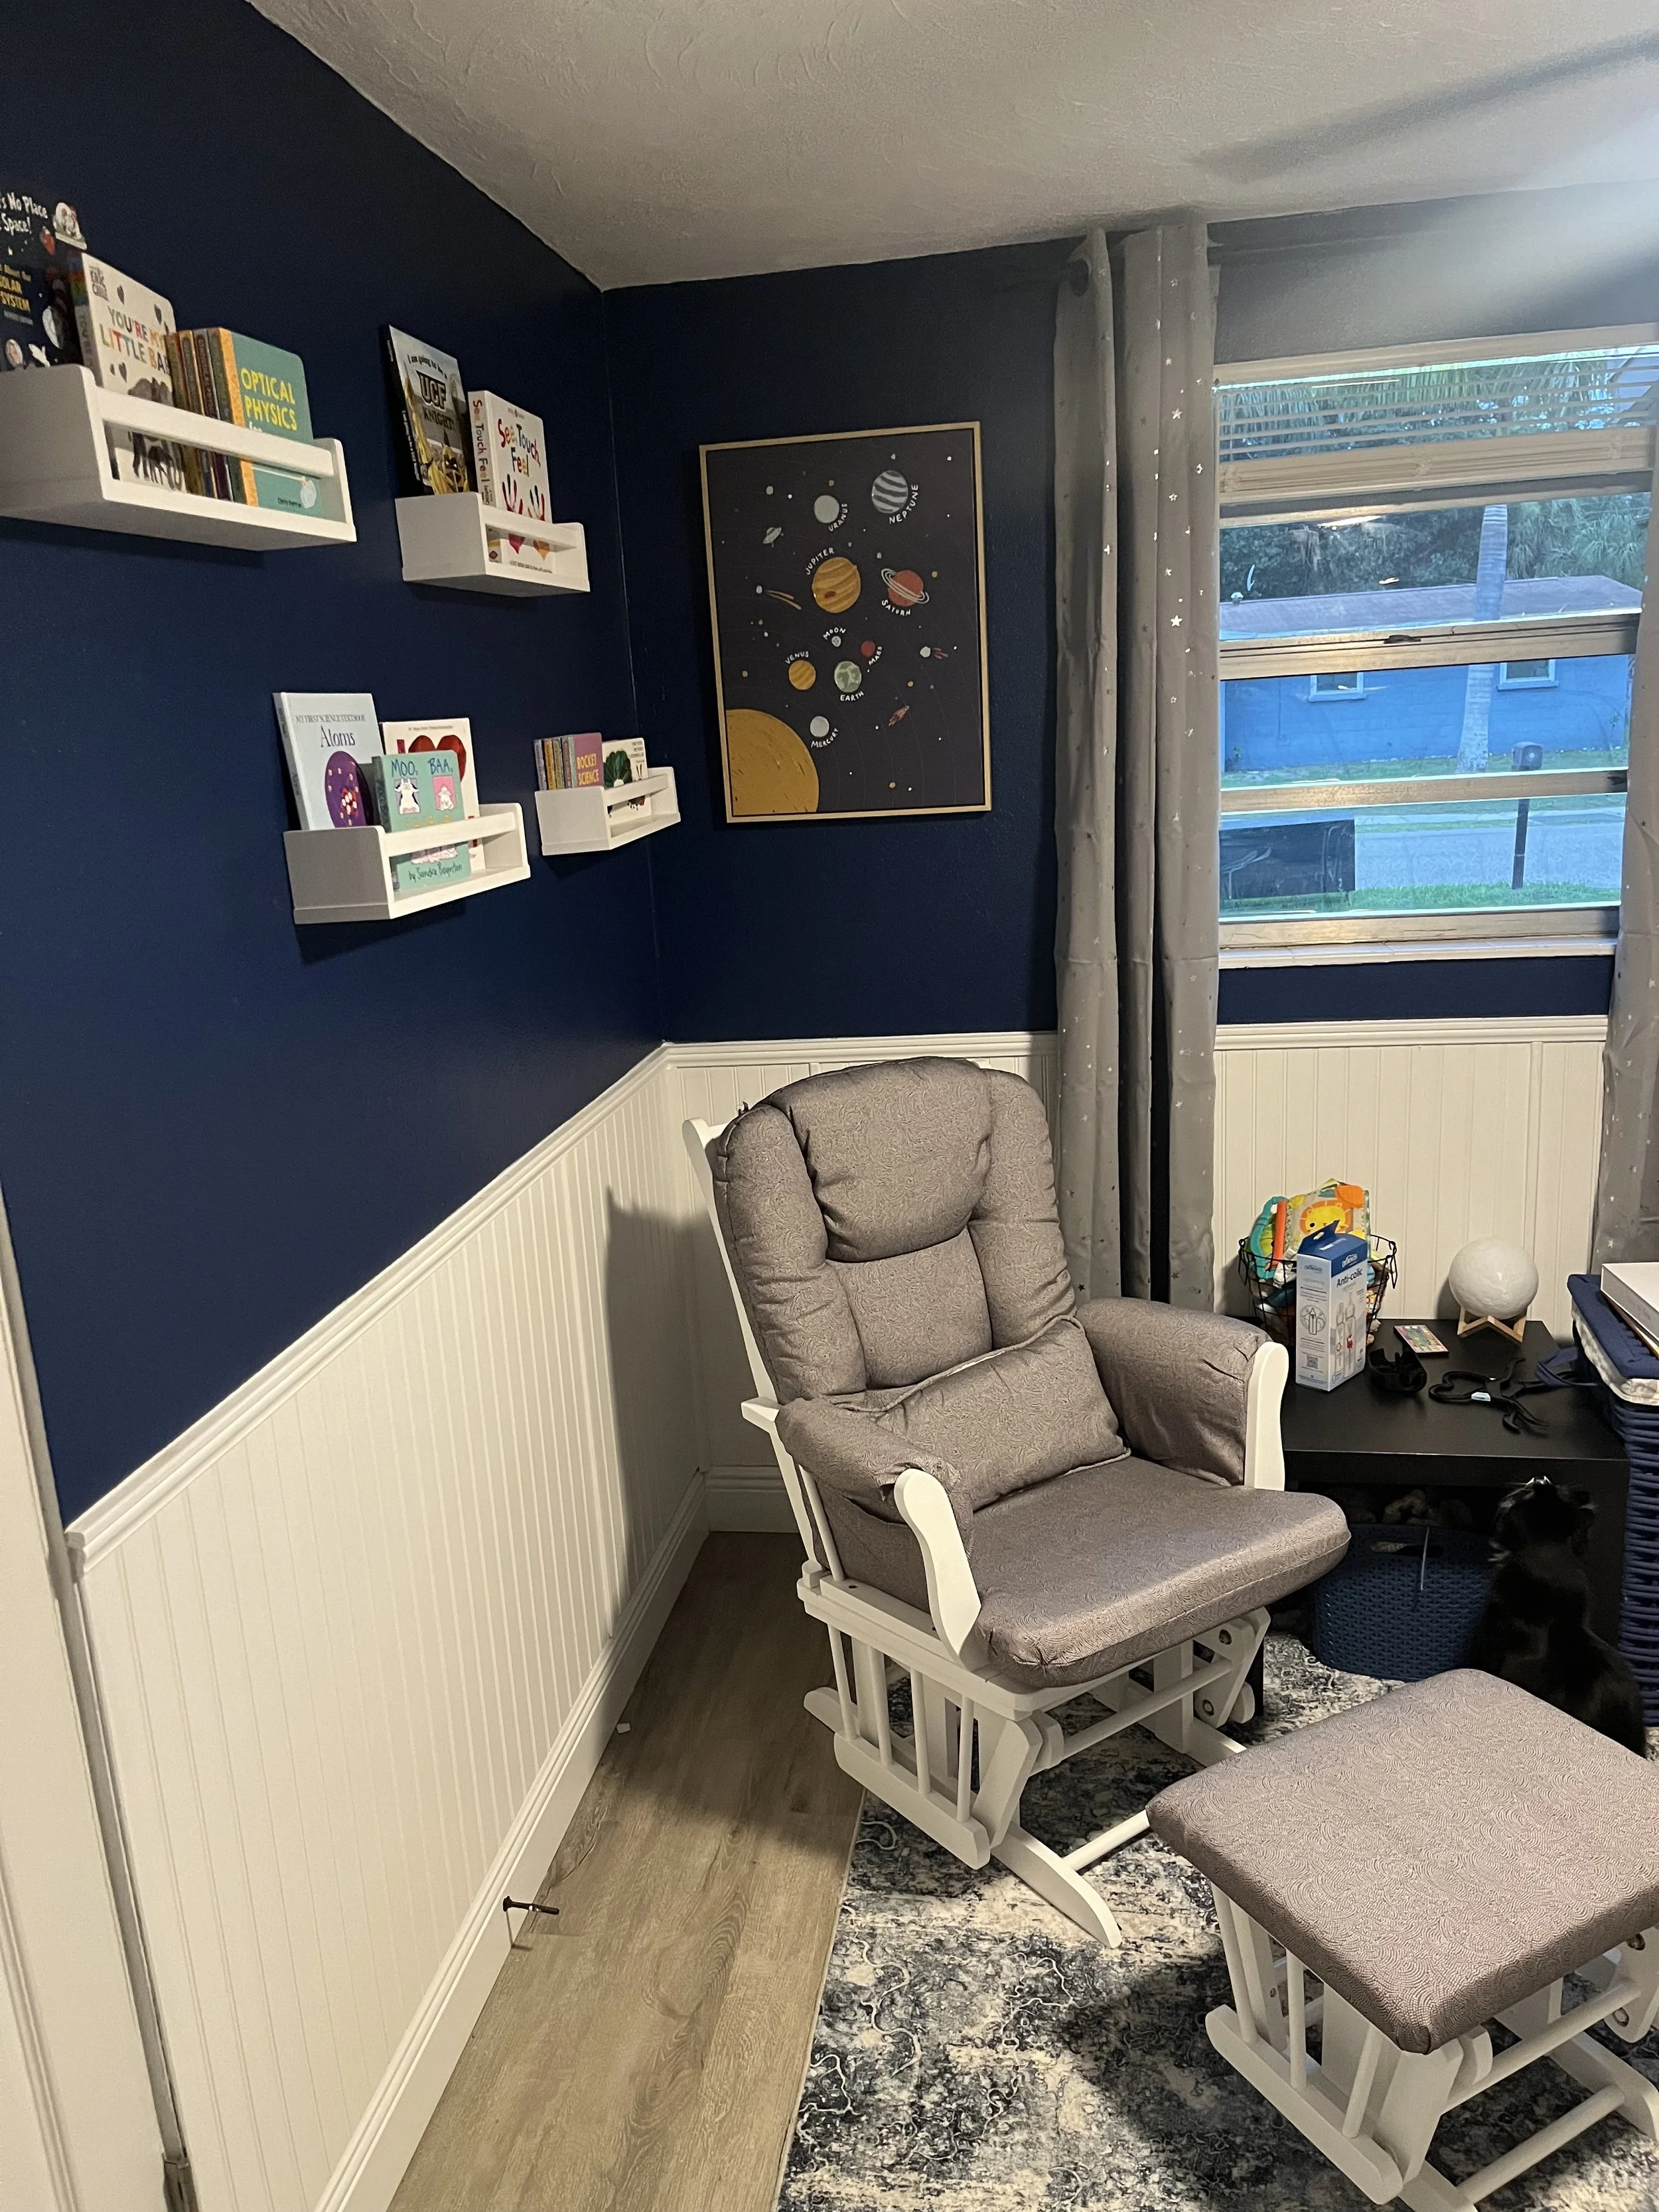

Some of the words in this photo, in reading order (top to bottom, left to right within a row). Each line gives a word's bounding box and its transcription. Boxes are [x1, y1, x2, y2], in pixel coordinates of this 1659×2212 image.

[7, 191, 22, 212] No
[22, 196, 48, 220] Place
[1, 212, 32, 237] Space!
[1, 291, 31, 313] SYSTEM
[108, 304, 149, 343] YOU'RE
[100, 323, 147, 364] LITTLE
[240, 368, 296, 406] OPTICAL
[415, 370, 447, 412] UCF
[244, 395, 297, 431] PHYSICS
[475, 424, 486, 455] Touch
[478, 458, 490, 482] Feel
[510, 447, 530, 477] Feel
[889, 484, 919, 524] NEPTUNE
[828, 503, 849, 532] URANUS
[805, 547, 835, 575] JUPITER
[881, 599, 912, 617] SATURN
[822, 627, 847, 640] MOON
[784, 650, 810, 664] VENUS
[868, 645, 883, 666] MARS
[839, 690, 865, 701] EARTH
[321, 725, 356, 747] Atoms
[810, 727, 839, 749] MERCURY
[391, 759, 419, 778] MOO,
[427, 757, 453, 775] BAA,
[576, 753, 597, 770] ROCKET
[578, 769, 599, 786] SCIENCE
[408, 869, 417, 883] by
[416, 866, 438, 881] Sandra
[437, 861, 463, 878] Boynton
[1336, 1268, 1363, 1288] Anti-colic
